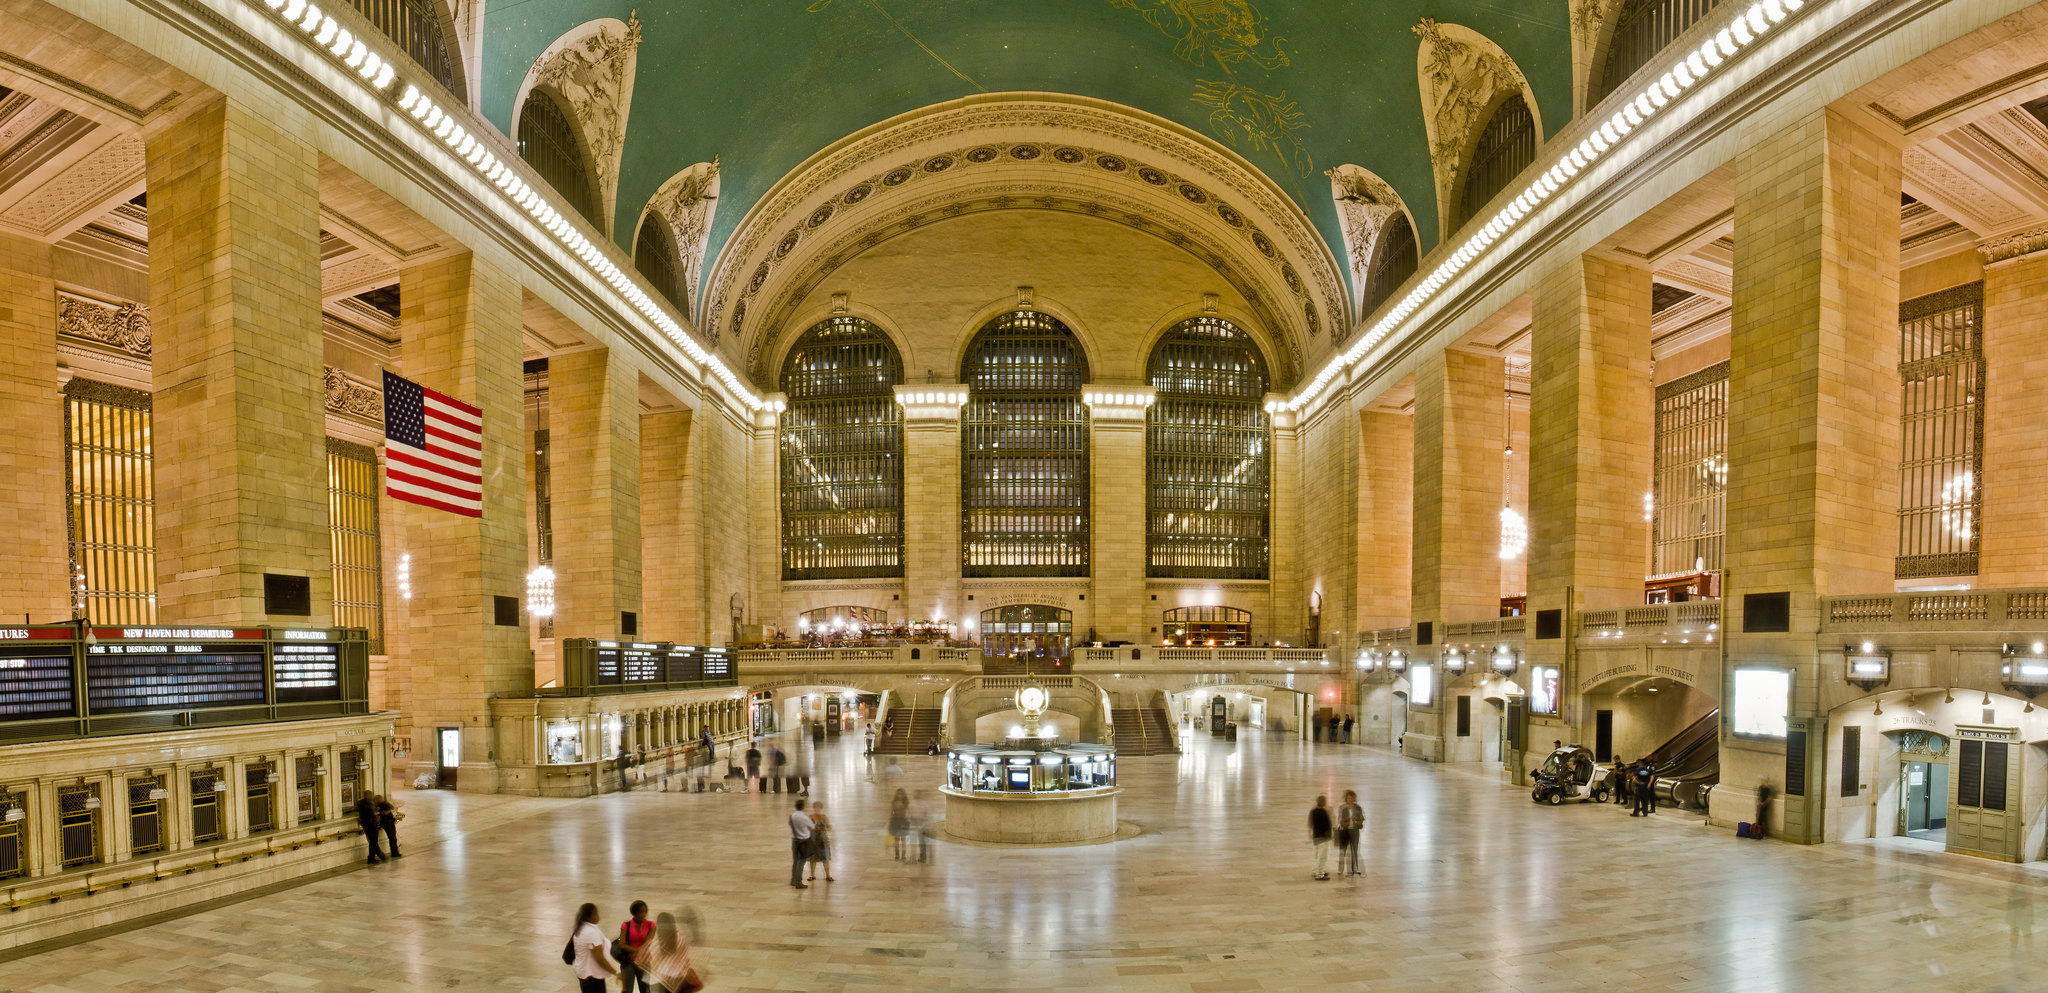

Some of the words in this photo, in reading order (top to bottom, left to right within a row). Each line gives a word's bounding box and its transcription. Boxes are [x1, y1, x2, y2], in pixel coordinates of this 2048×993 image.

[0, 629, 29, 639] TURES
[123, 629, 143, 638] NEW
[145, 629, 172, 638] HAVEN
[173, 629, 190, 638] LINE
[191, 629, 234, 638] DEPARTURES
[285, 631, 327, 640] INFORMATION
[89, 646, 106, 654] TIME
[126, 645, 167, 653] DESTINATION
[174, 645, 202, 653] REMARKS
[10, 659, 26, 668] STOP
[1612, 664, 1637, 675] BUILDING
[1655, 665, 1670, 675] 45TH
[1671, 668, 1694, 681] STREET
[752, 682, 776, 690] SUBWAY
[1902, 716, 1928, 726] TRACKS
